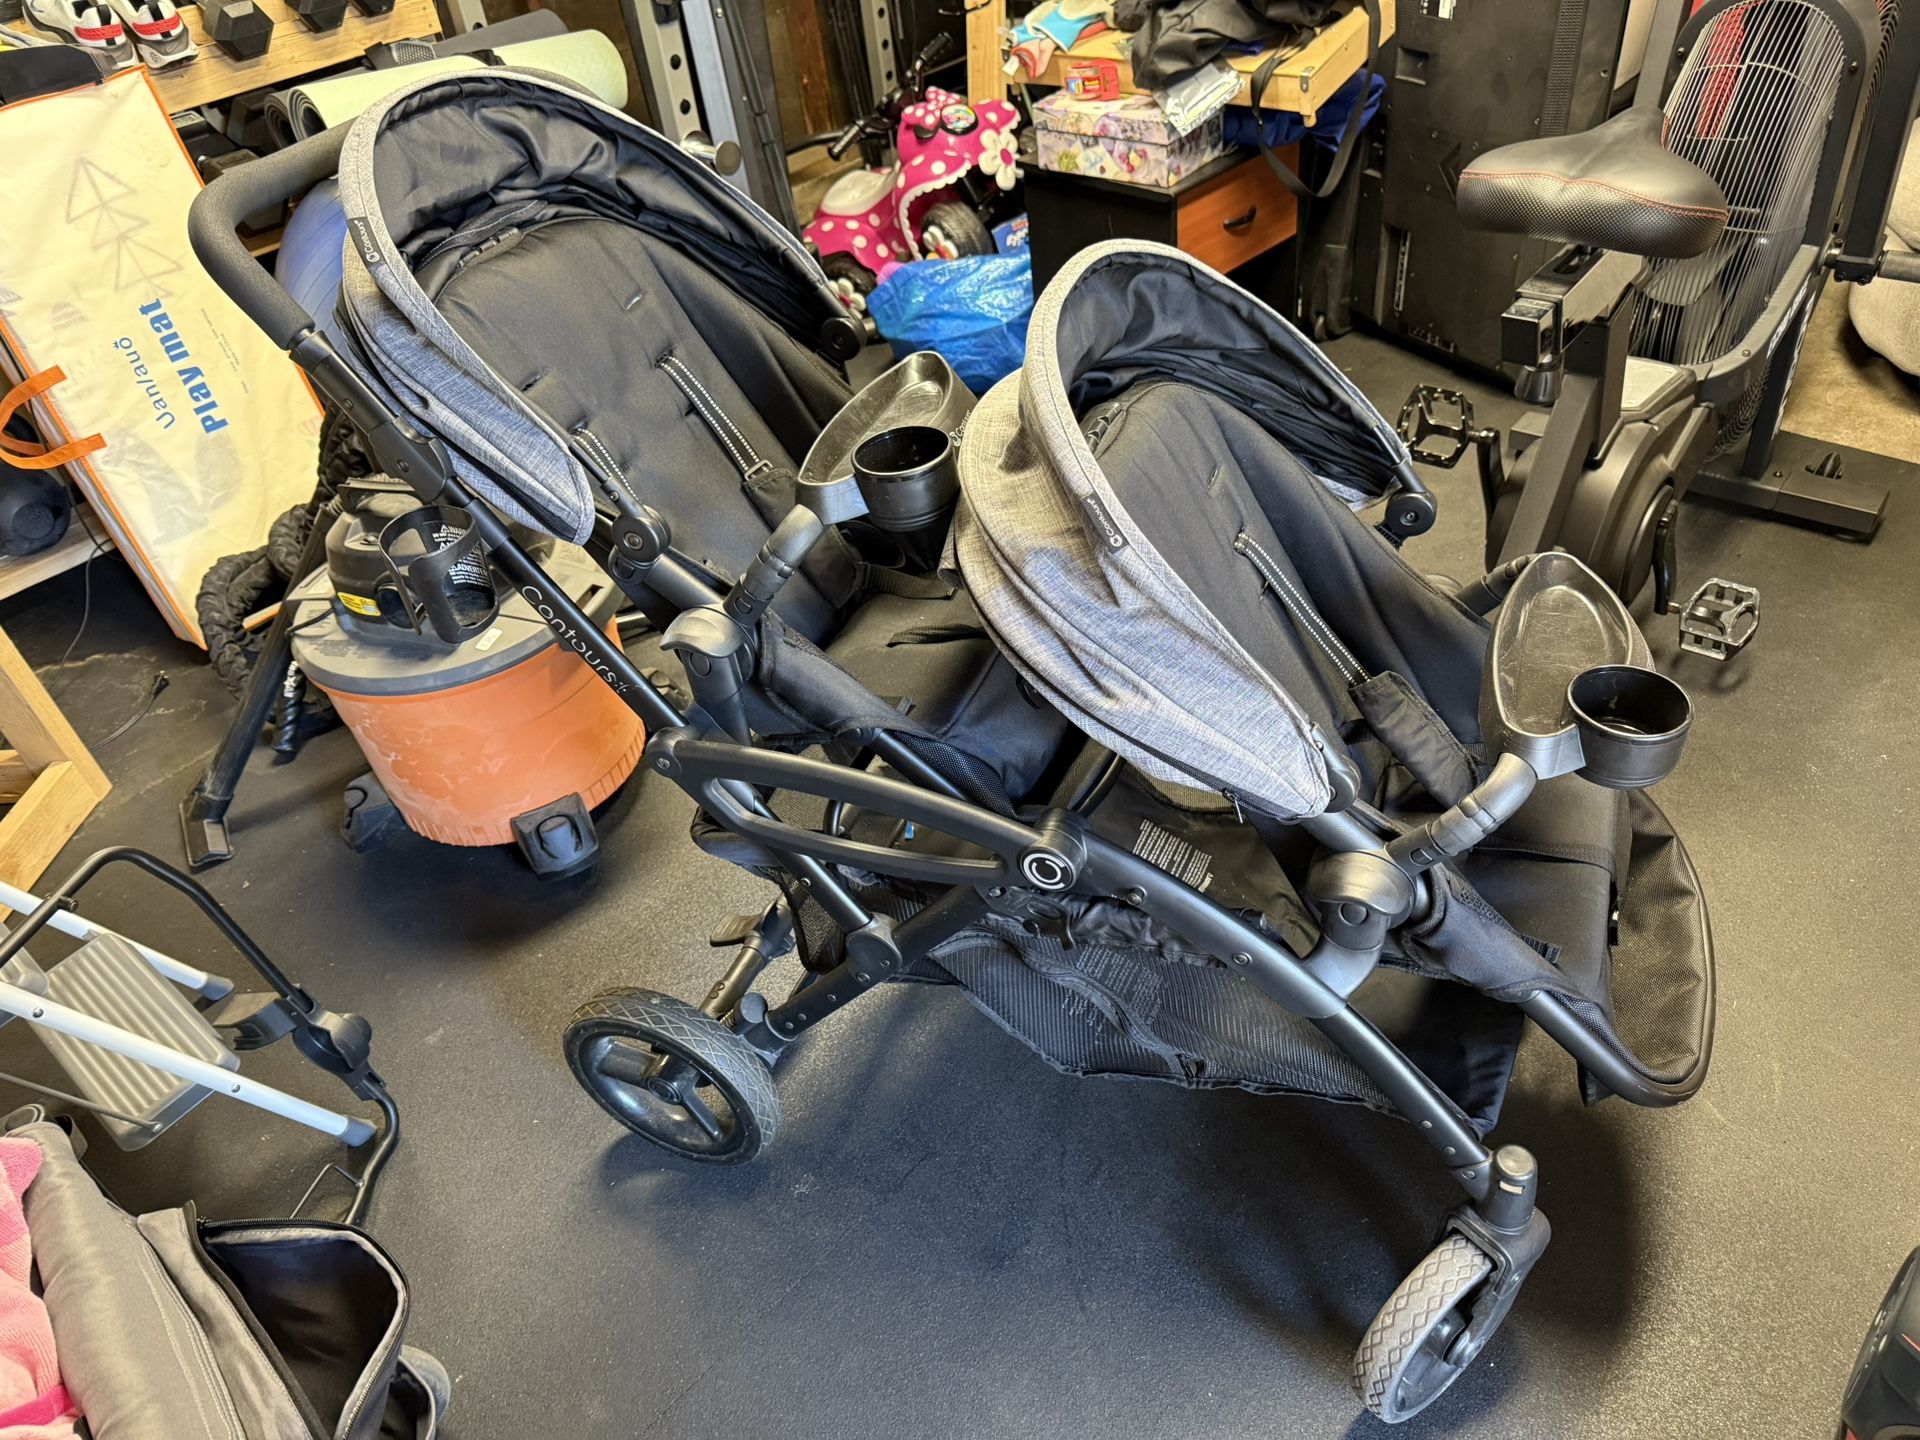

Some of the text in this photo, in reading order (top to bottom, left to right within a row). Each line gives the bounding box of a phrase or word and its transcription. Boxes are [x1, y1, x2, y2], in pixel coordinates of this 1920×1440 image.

[138, 298, 229, 433] Play mat
[522, 586, 617, 683] Contours
